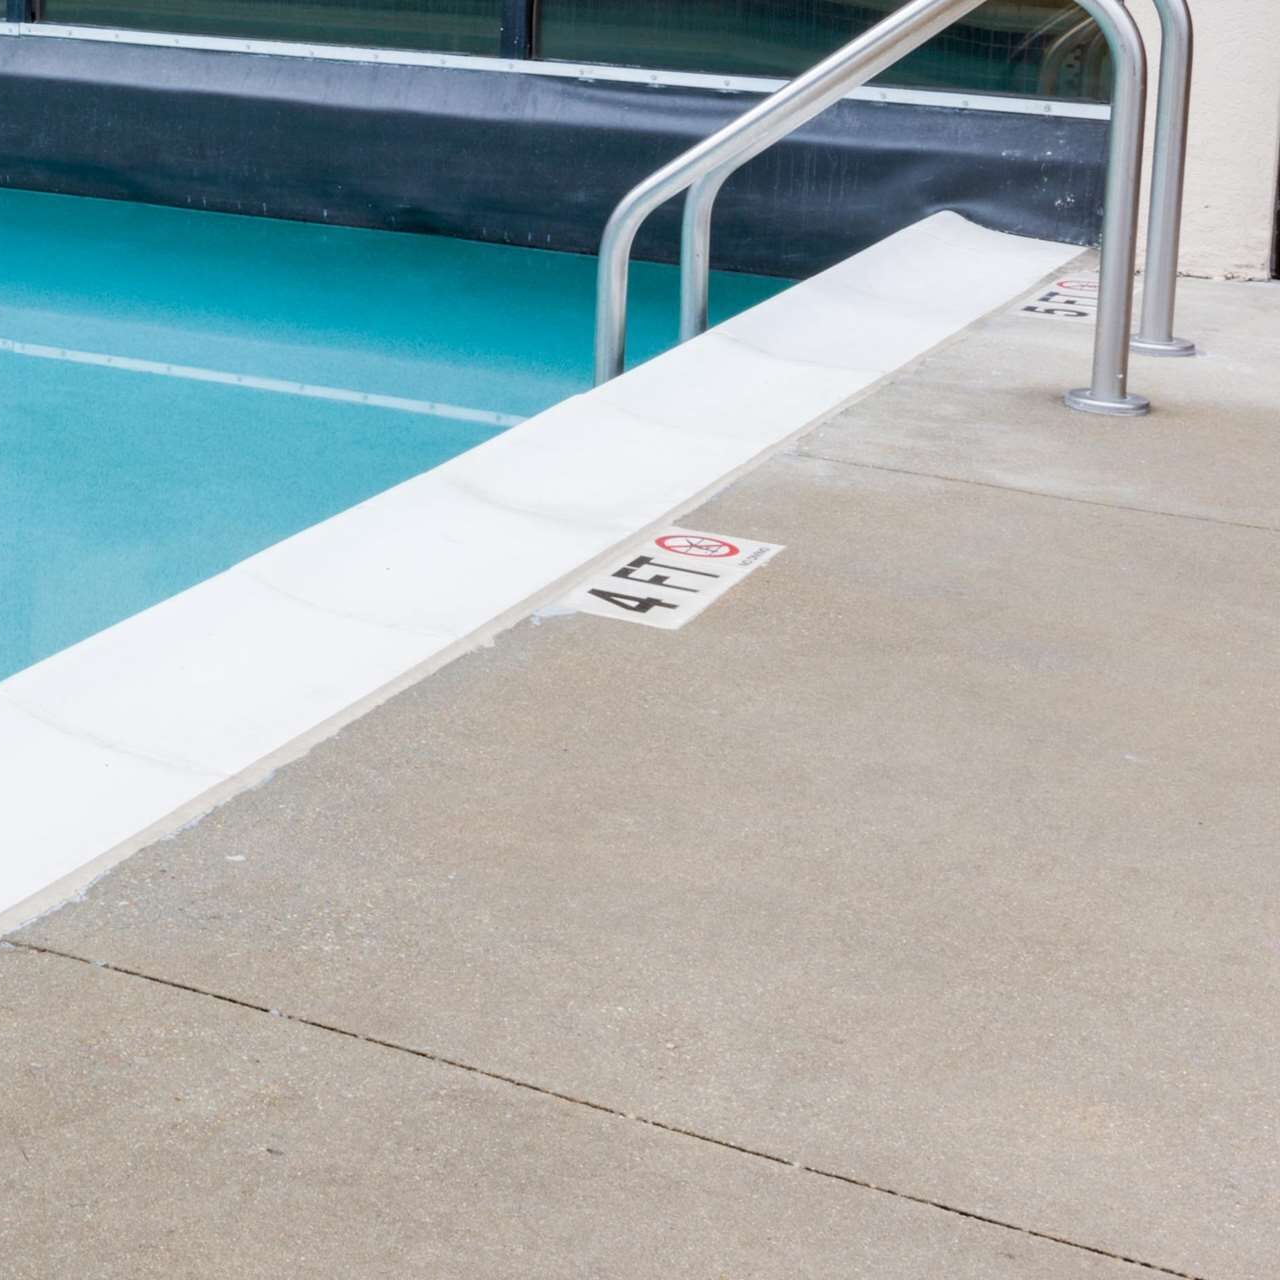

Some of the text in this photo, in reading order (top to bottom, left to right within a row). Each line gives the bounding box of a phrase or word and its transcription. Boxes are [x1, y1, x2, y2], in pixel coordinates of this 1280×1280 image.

[1021, 306, 1088, 317] 5
[610, 555, 721, 593] FT
[587, 587, 680, 614] 4
